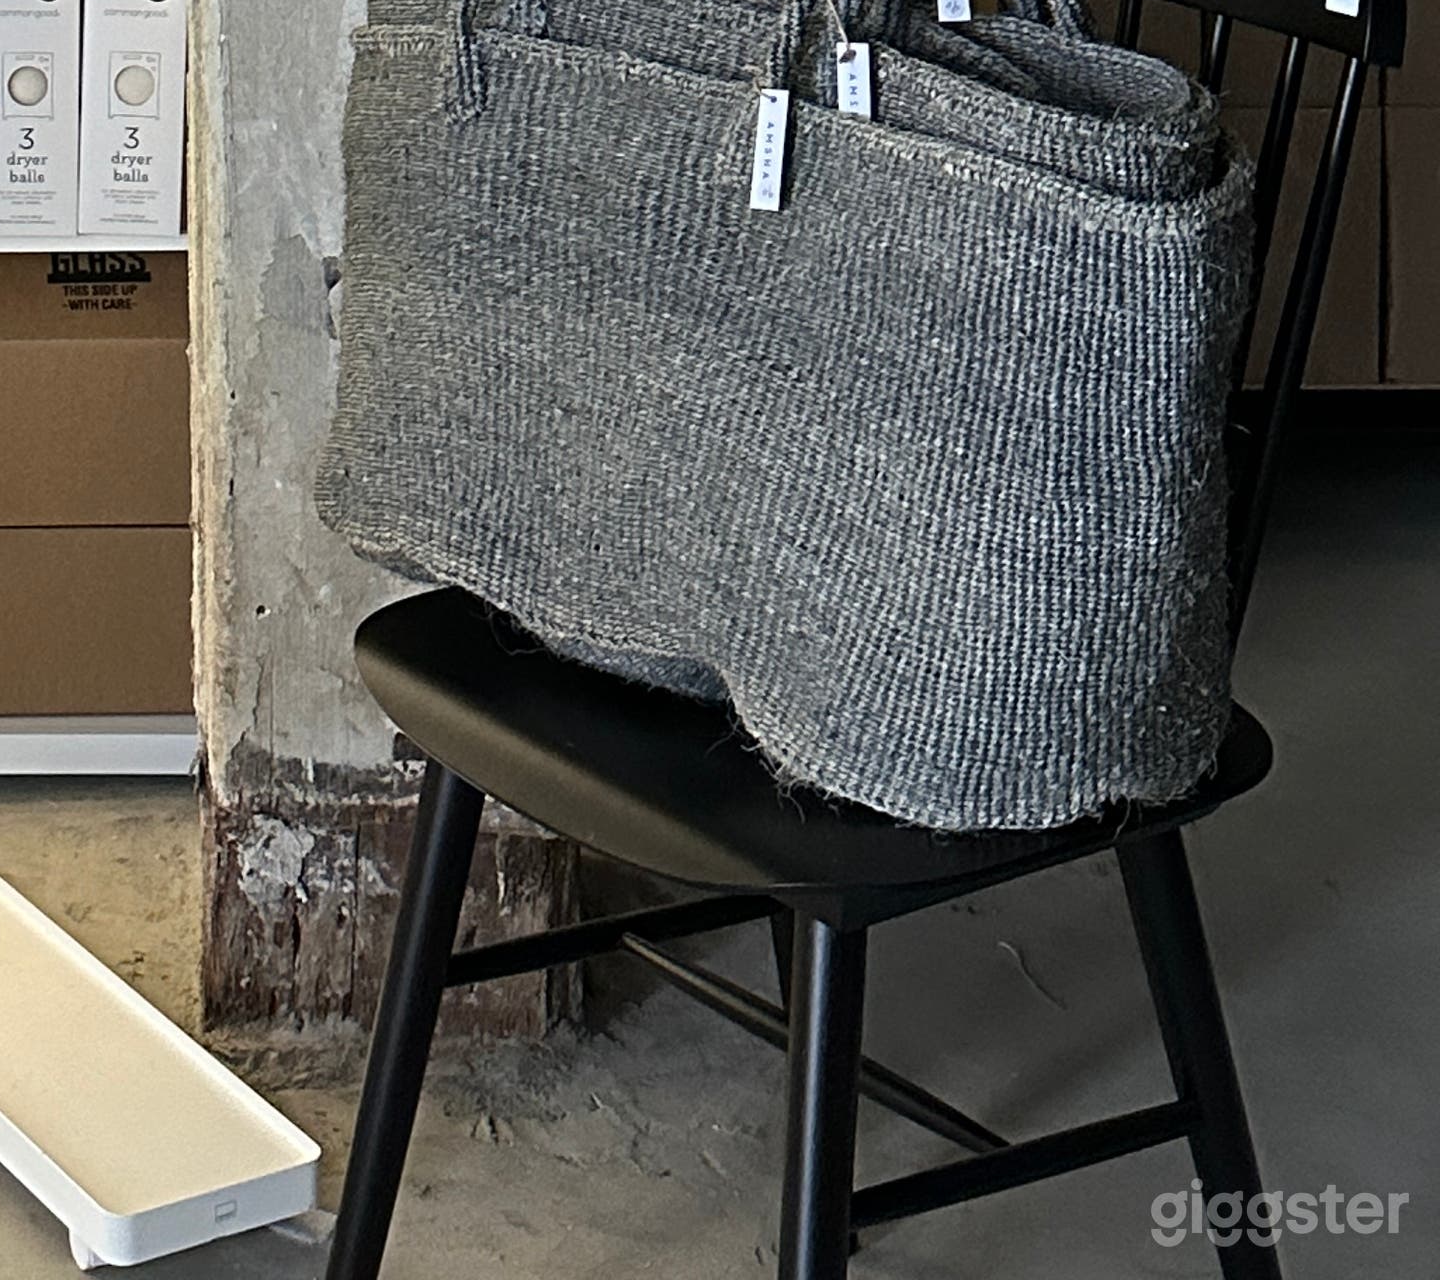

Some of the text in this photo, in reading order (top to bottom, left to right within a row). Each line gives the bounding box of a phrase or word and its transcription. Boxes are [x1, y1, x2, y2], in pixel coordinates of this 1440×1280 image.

[18, 127, 35, 150] 3
[123, 126, 140, 150] 3
[6, 152, 49, 170] dryer
[110, 151, 153, 170] dryer
[9, 170, 46, 184] balls
[112, 169, 149, 183] balls
[63, 284, 138, 296] THIS SIDE UP
